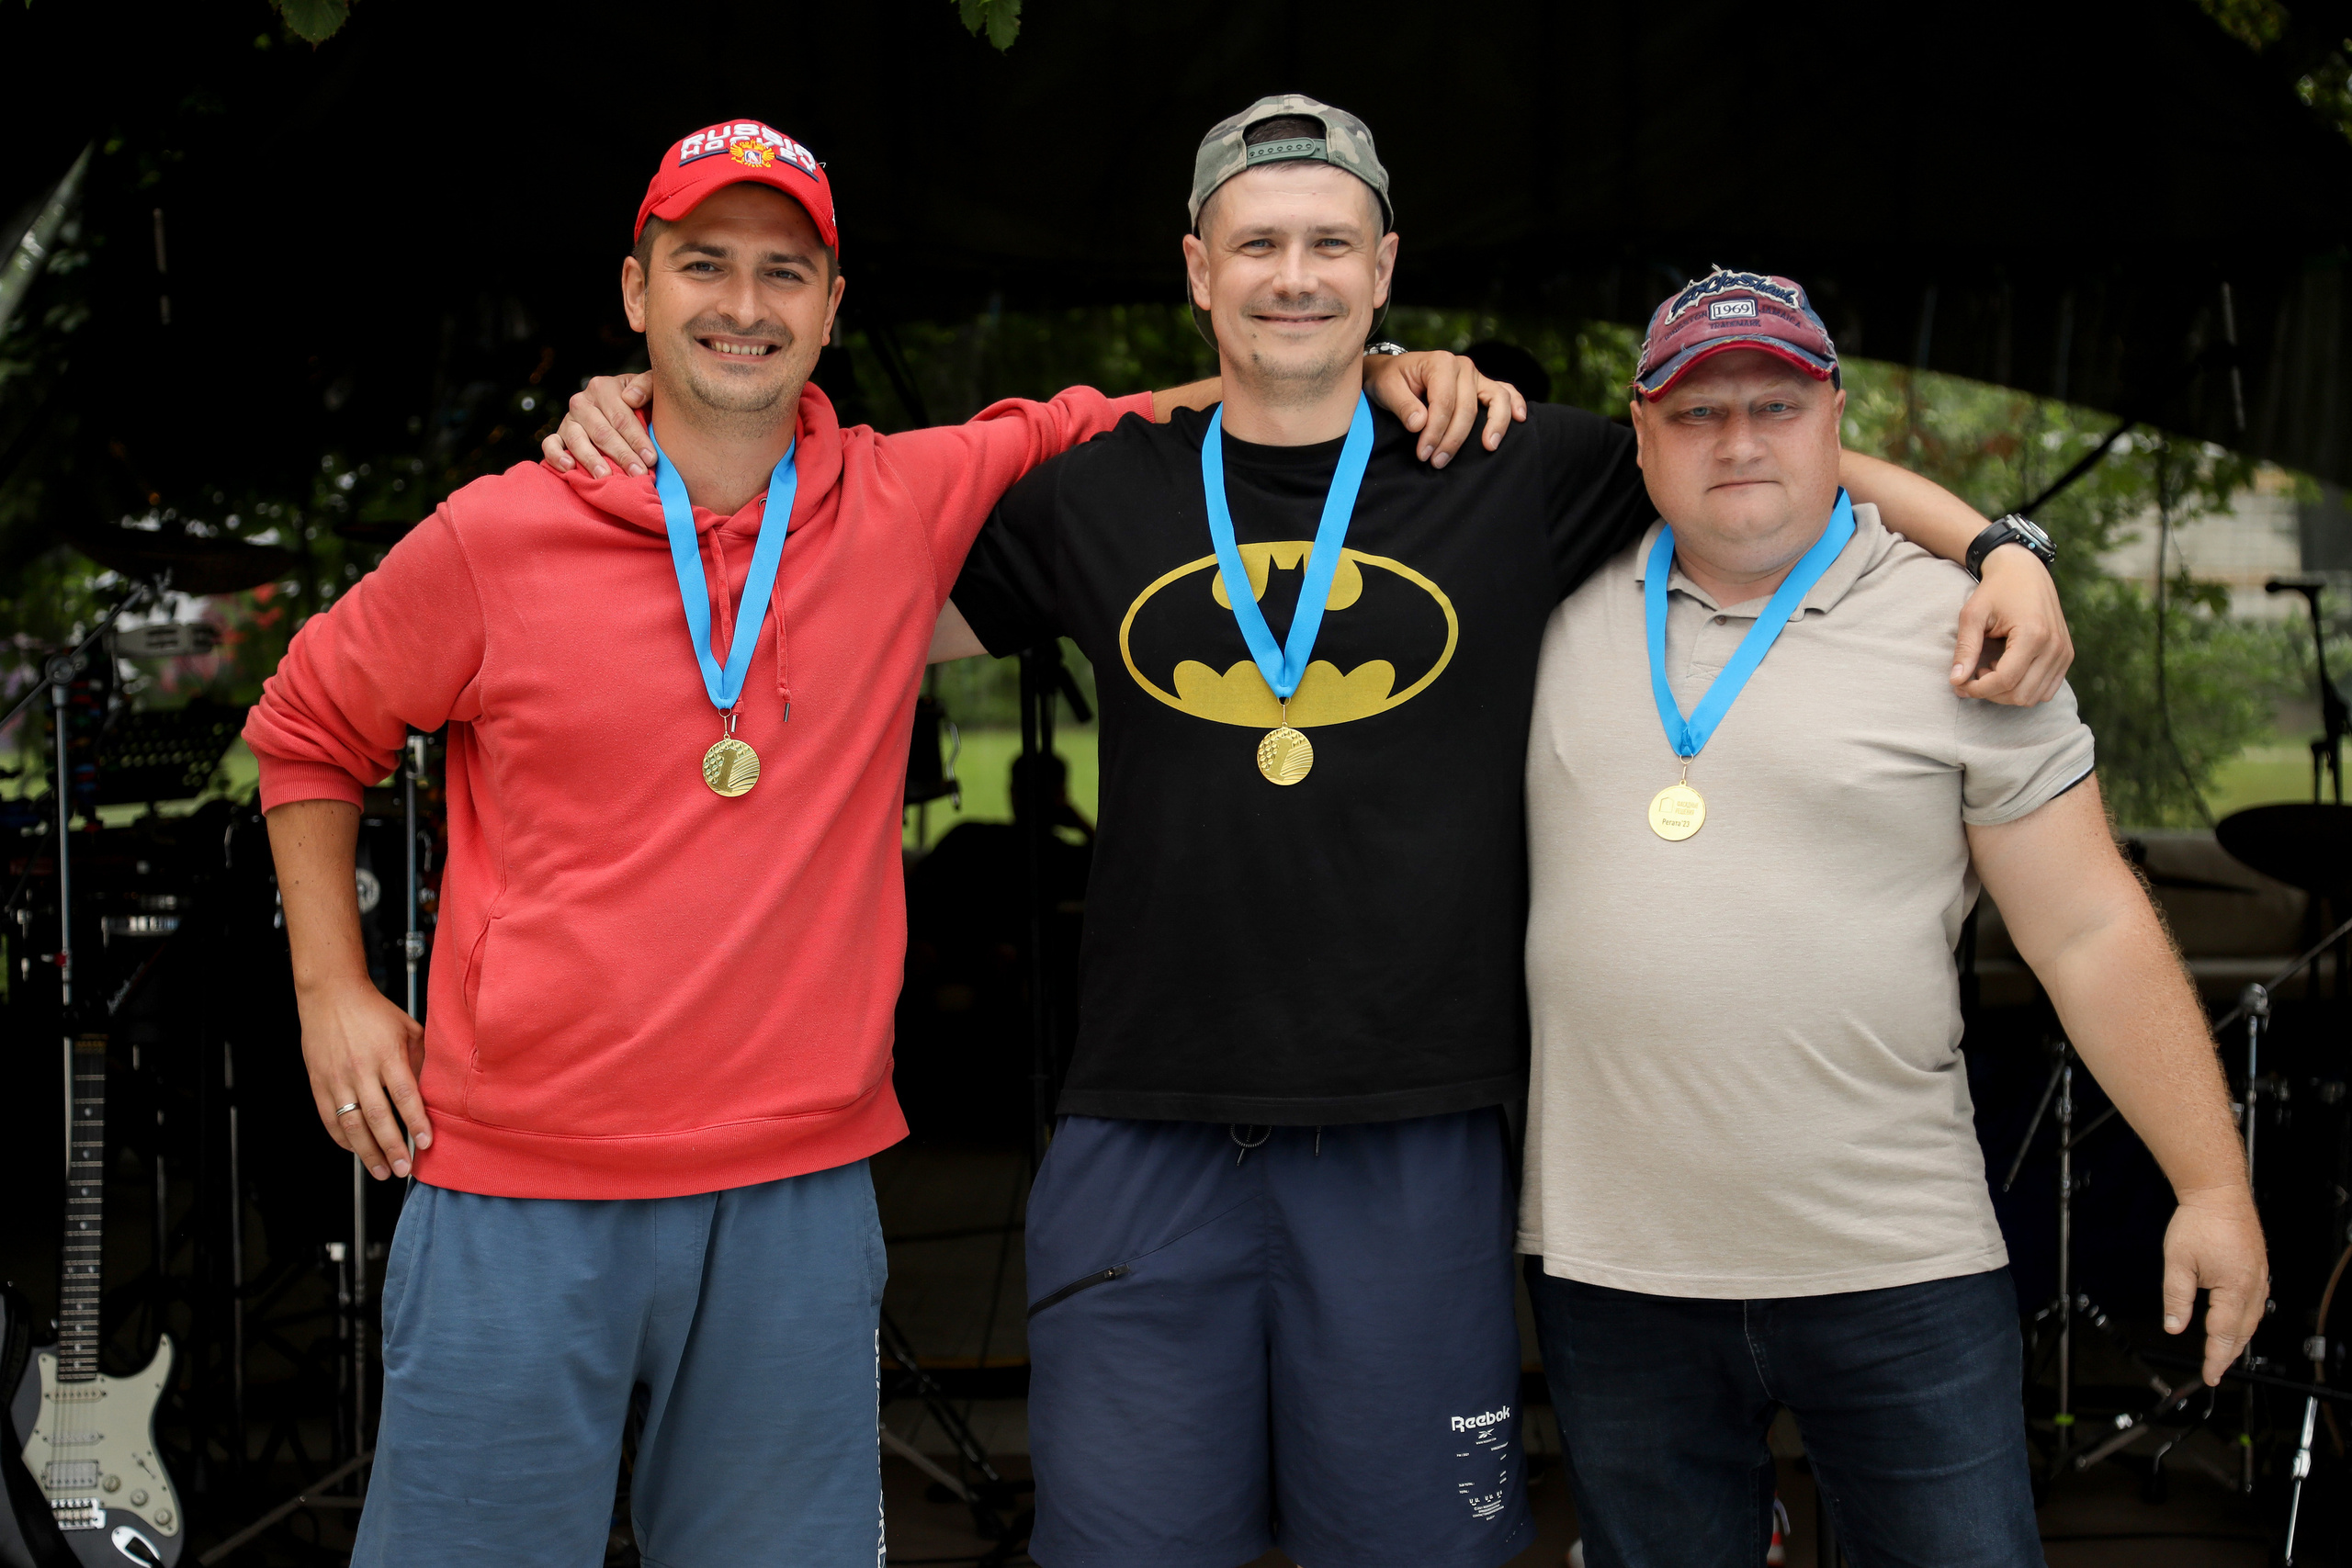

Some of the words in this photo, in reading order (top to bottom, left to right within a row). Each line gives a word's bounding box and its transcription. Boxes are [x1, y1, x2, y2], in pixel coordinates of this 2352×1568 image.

[681, 123, 816, 167] RUSSIA
[1714, 303, 1750, 316] 1969
[1709, 319, 1761, 329] TRADEMARK
[1452, 1405, 1510, 1432] Reebok
